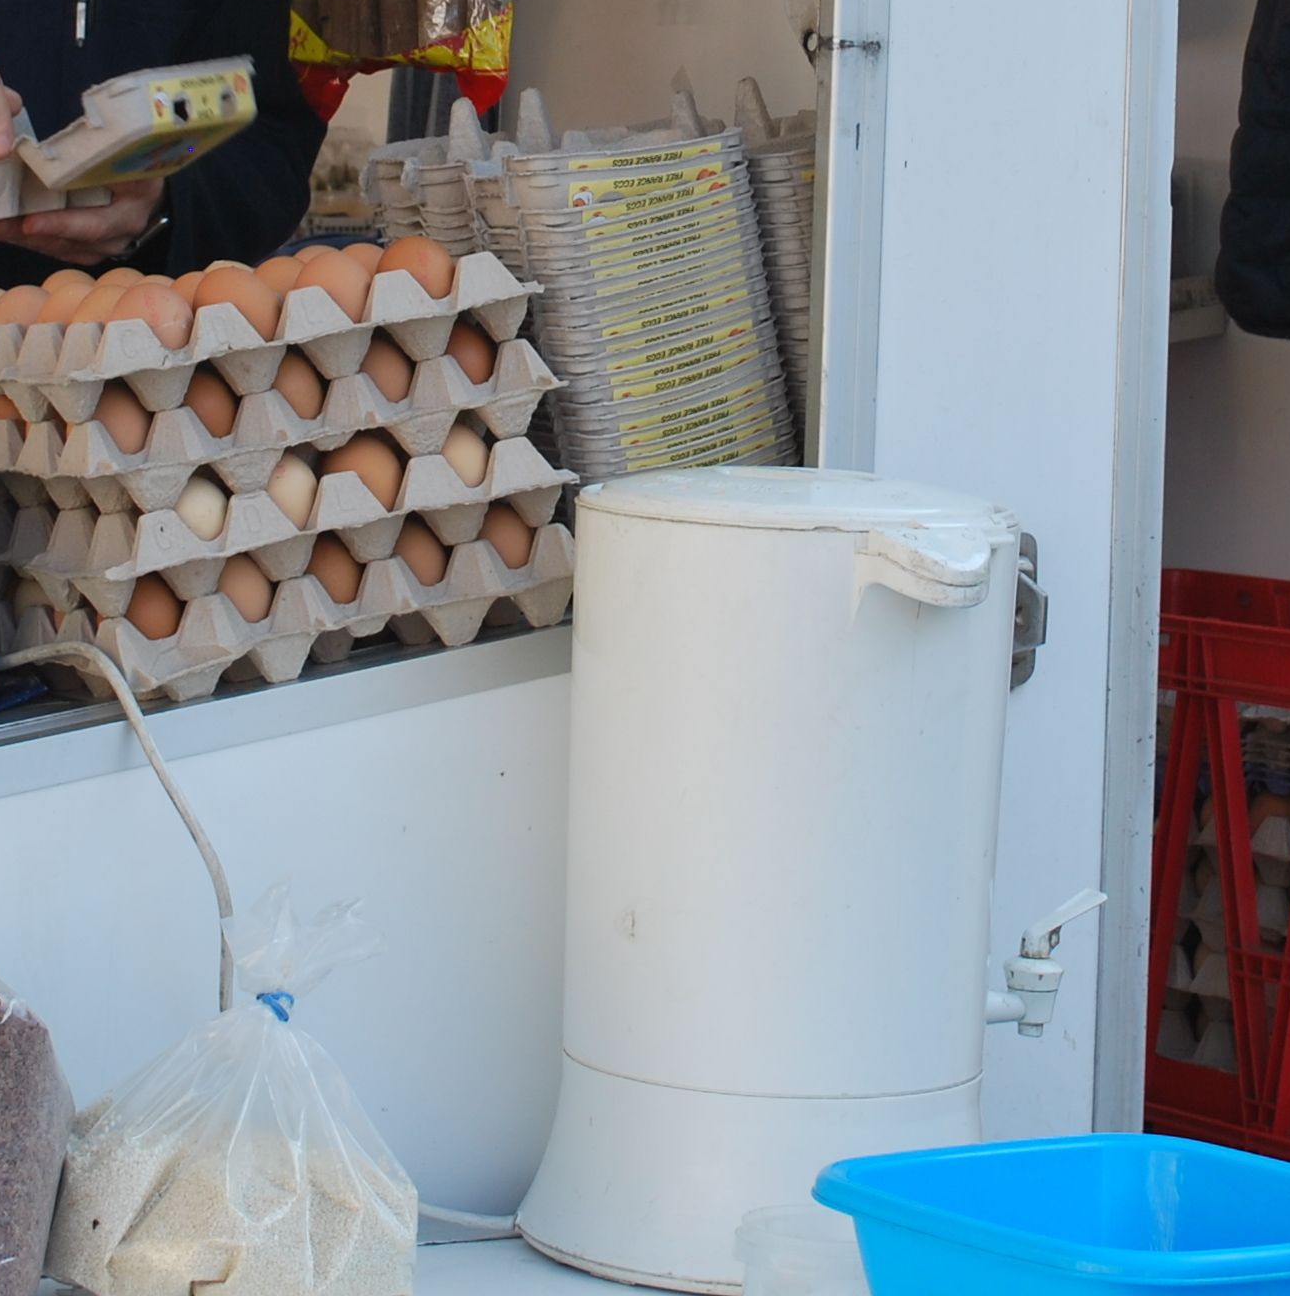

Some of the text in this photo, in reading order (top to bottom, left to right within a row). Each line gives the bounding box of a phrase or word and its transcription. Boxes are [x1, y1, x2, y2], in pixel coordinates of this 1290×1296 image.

[613, 171, 684, 189] FREE RANGE EGGS
[626, 187, 694, 211] FREE RANGE EGGS
[645, 336, 714, 363] FREE RANGE EGGS
[655, 365, 723, 392] FREE RANGE EGGS
